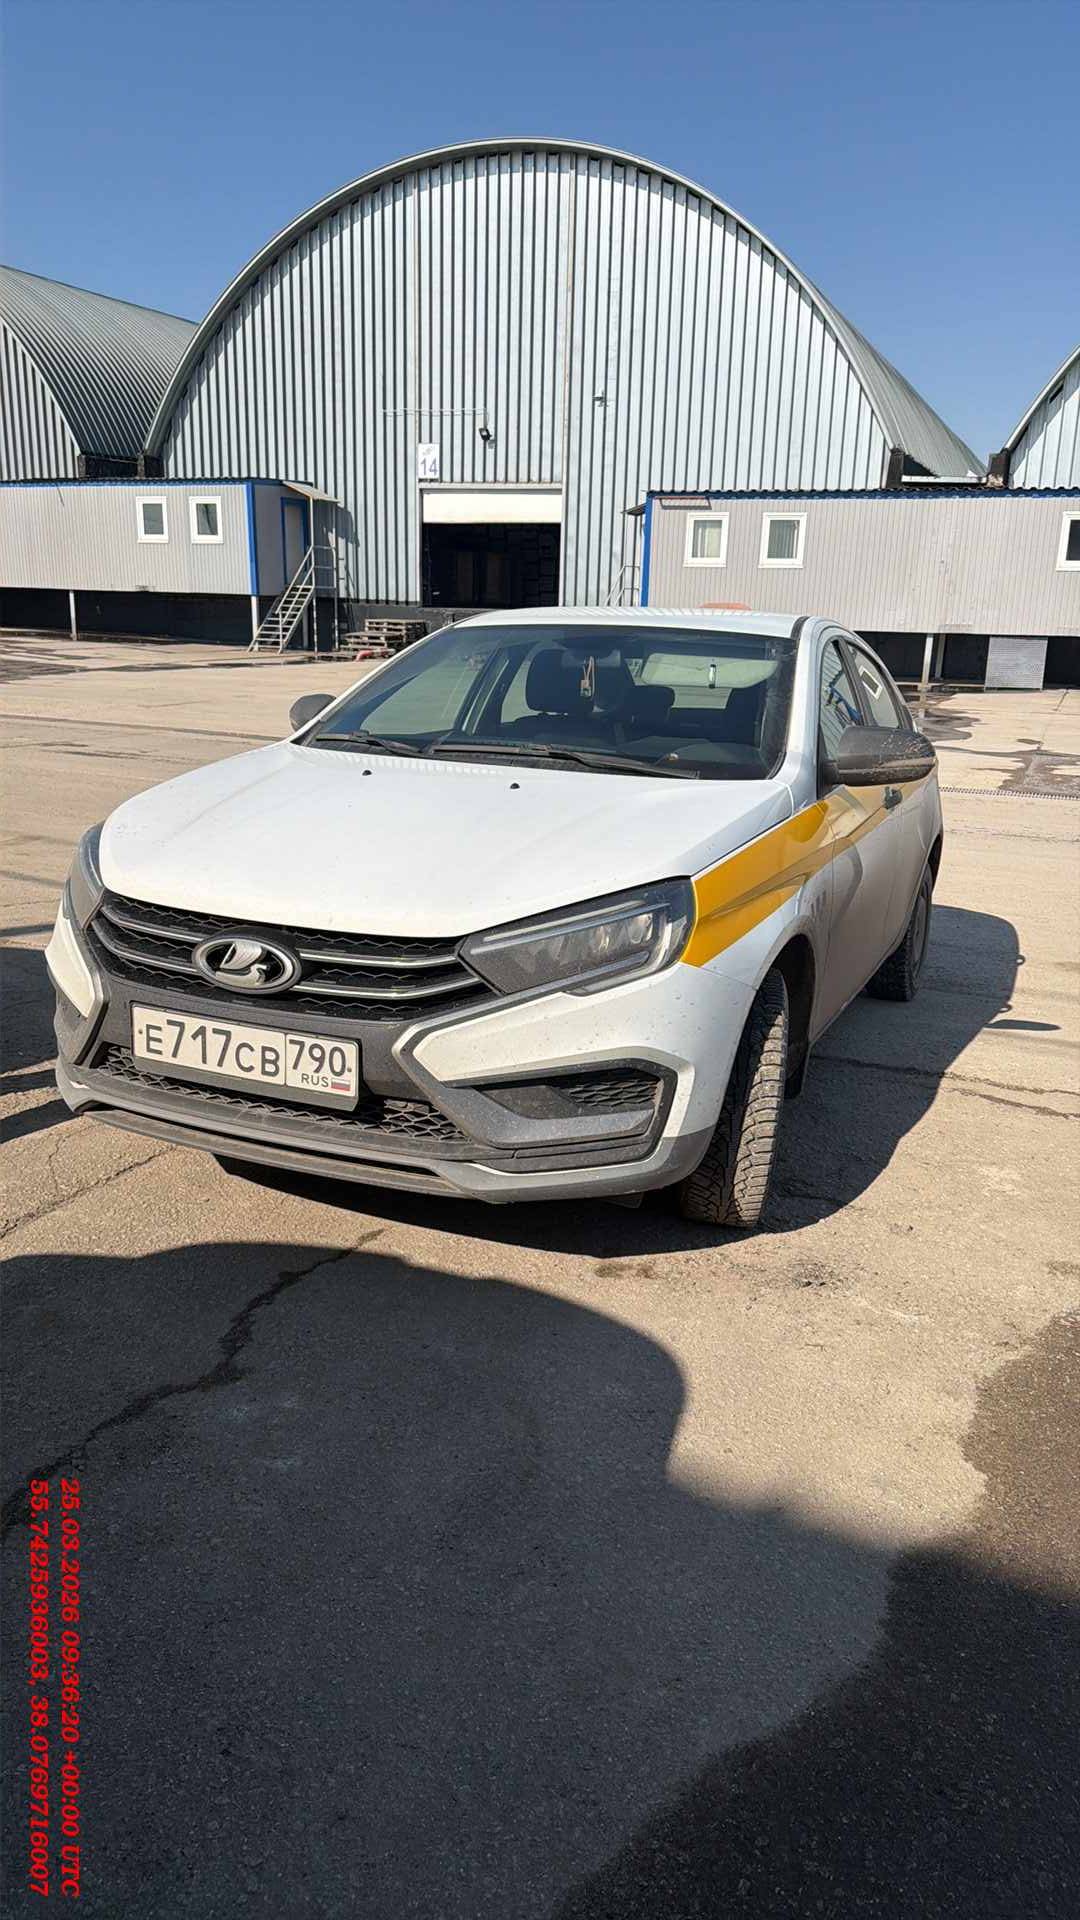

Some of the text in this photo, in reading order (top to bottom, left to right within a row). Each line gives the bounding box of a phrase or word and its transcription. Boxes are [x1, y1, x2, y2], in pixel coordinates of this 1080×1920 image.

[420, 457, 438, 476] 14
[288, 1039, 346, 1077] 790
[301, 1072, 329, 1088] RUS
